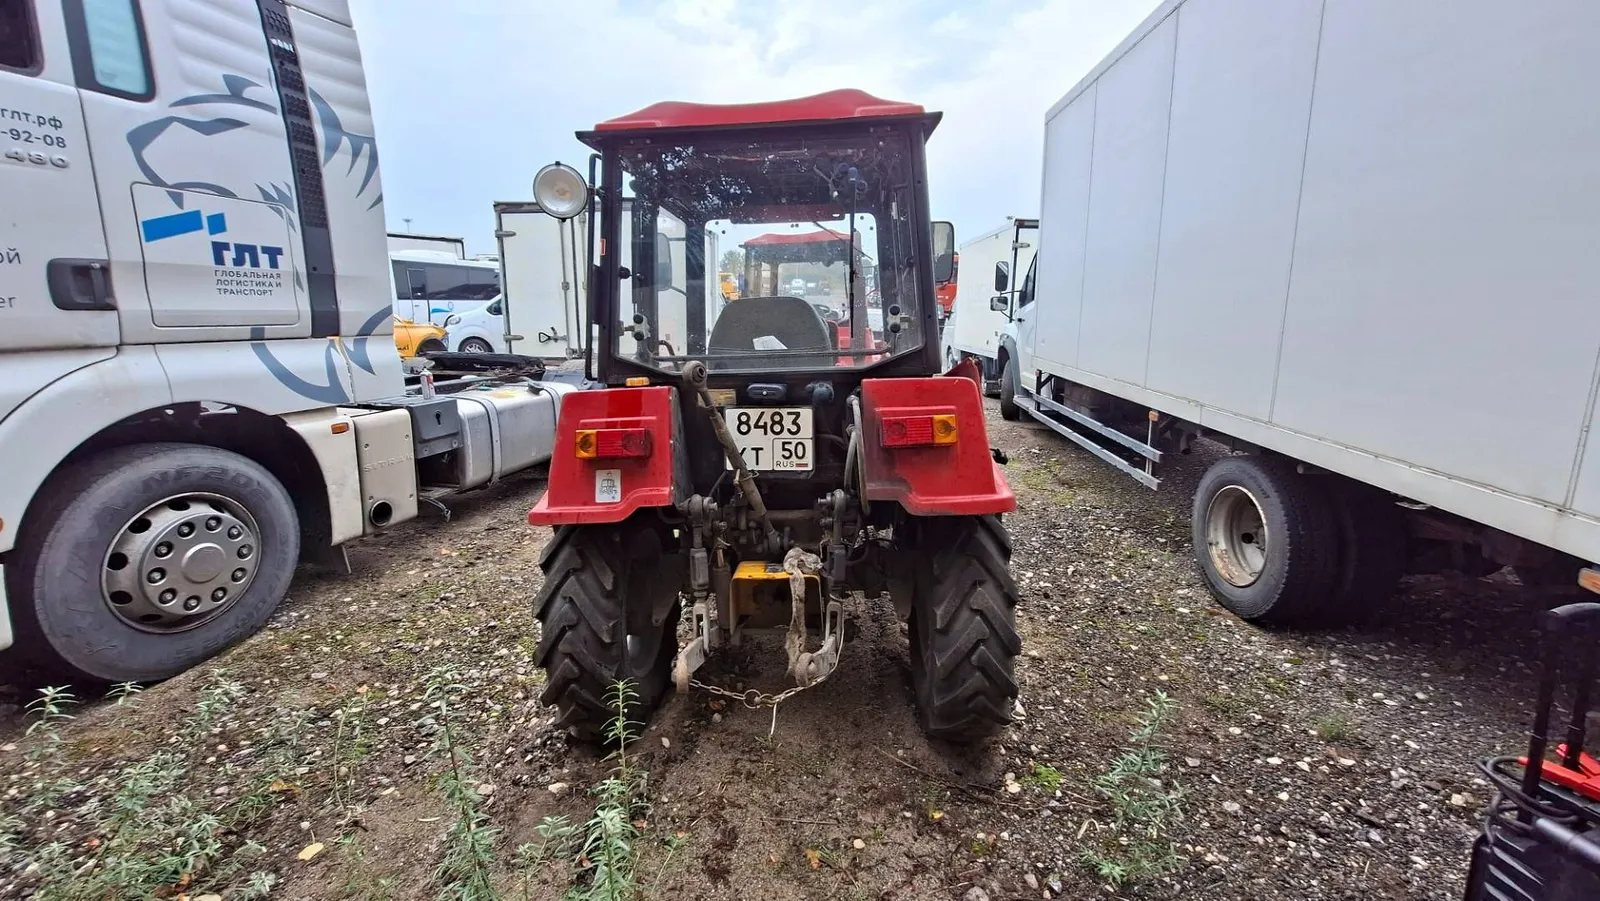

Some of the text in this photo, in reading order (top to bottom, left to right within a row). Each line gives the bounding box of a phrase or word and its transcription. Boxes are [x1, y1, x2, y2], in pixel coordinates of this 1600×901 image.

[211, 241, 284, 269] ГЛТ
[214, 270, 282, 280] ГЛОБАЛЬНАЯ
[216, 279, 282, 288] ЛОГИСТИКА И
[216, 288, 274, 297] ТРАНСПОРТ
[736, 411, 801, 436] 8483
[781, 441, 806, 460] 50
